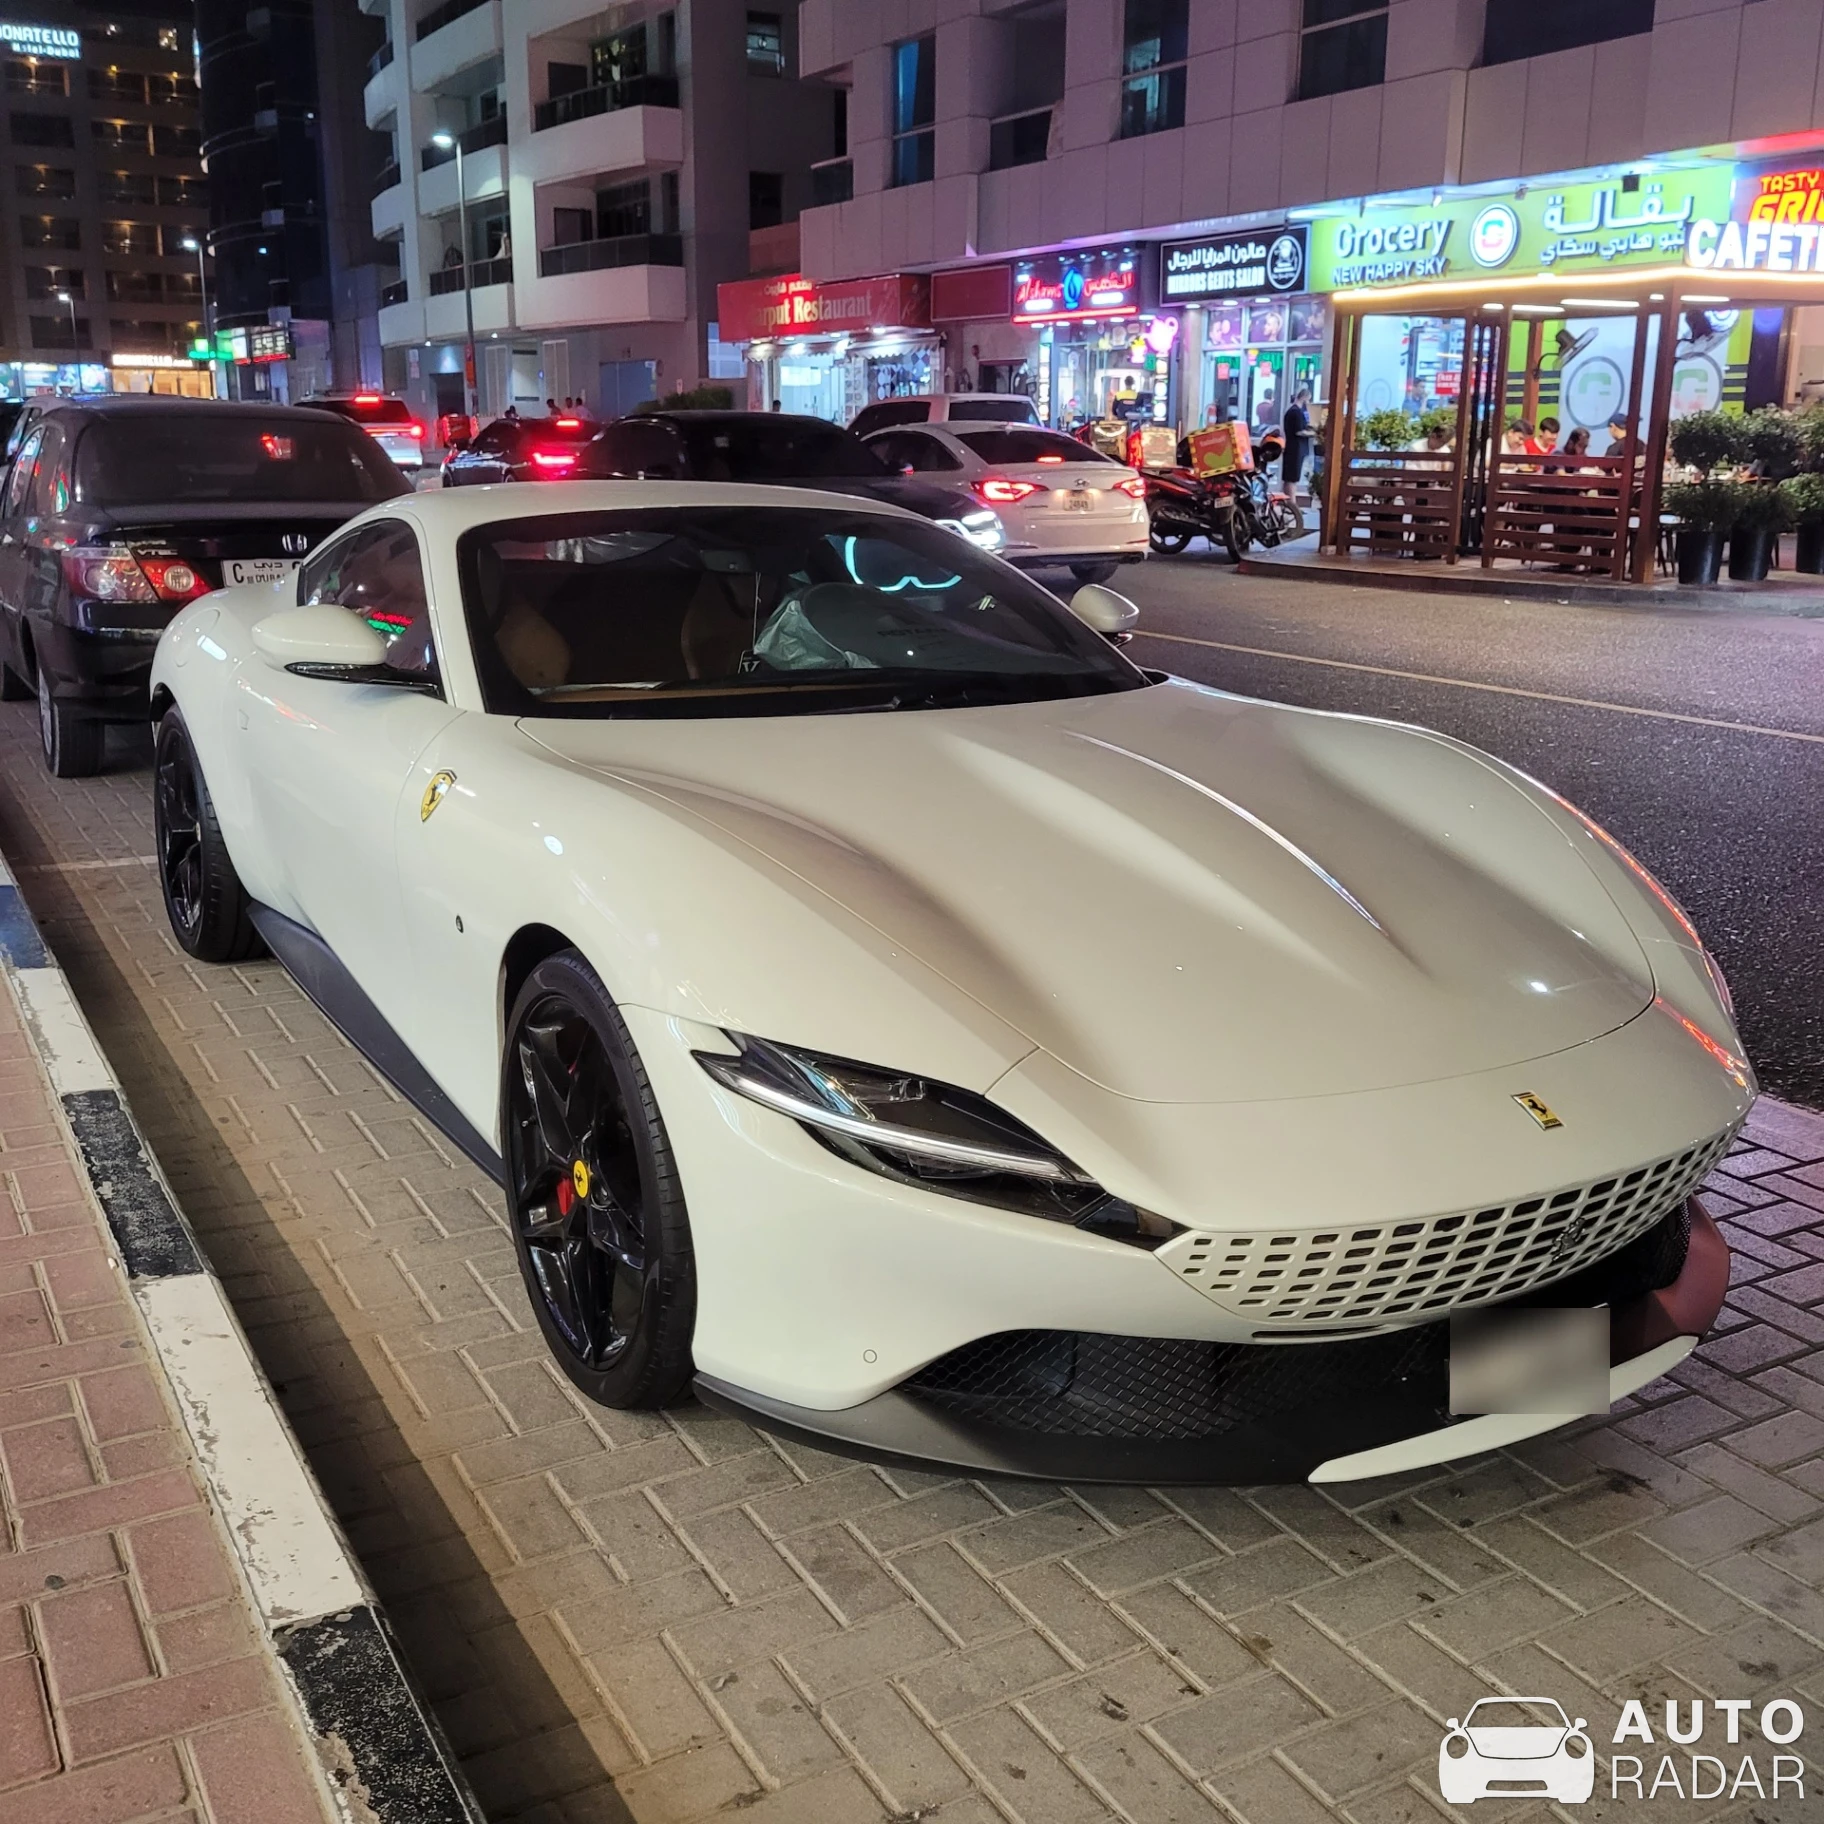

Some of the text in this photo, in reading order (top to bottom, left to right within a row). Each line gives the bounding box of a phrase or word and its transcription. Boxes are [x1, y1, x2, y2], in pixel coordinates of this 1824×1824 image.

[0, 23, 79, 47] ONATELLO
[1761, 171, 1820, 193] TASTY
[1543, 184, 1694, 234] بقالة
[1335, 220, 1452, 258] Grocery
[1600, 232, 1653, 260] هابي
[1688, 219, 1824, 271] CAFET
[1168, 249, 1201, 271] للرجال
[1232, 242, 1266, 264] صالون
[1540, 240, 1598, 265] سكاي
[1207, 269, 1235, 291] GENTS
[1332, 257, 1447, 284] NEW HAPPY SKY
[755, 295, 872, 332] arput Restaurant
[232, 562, 245, 584] C
